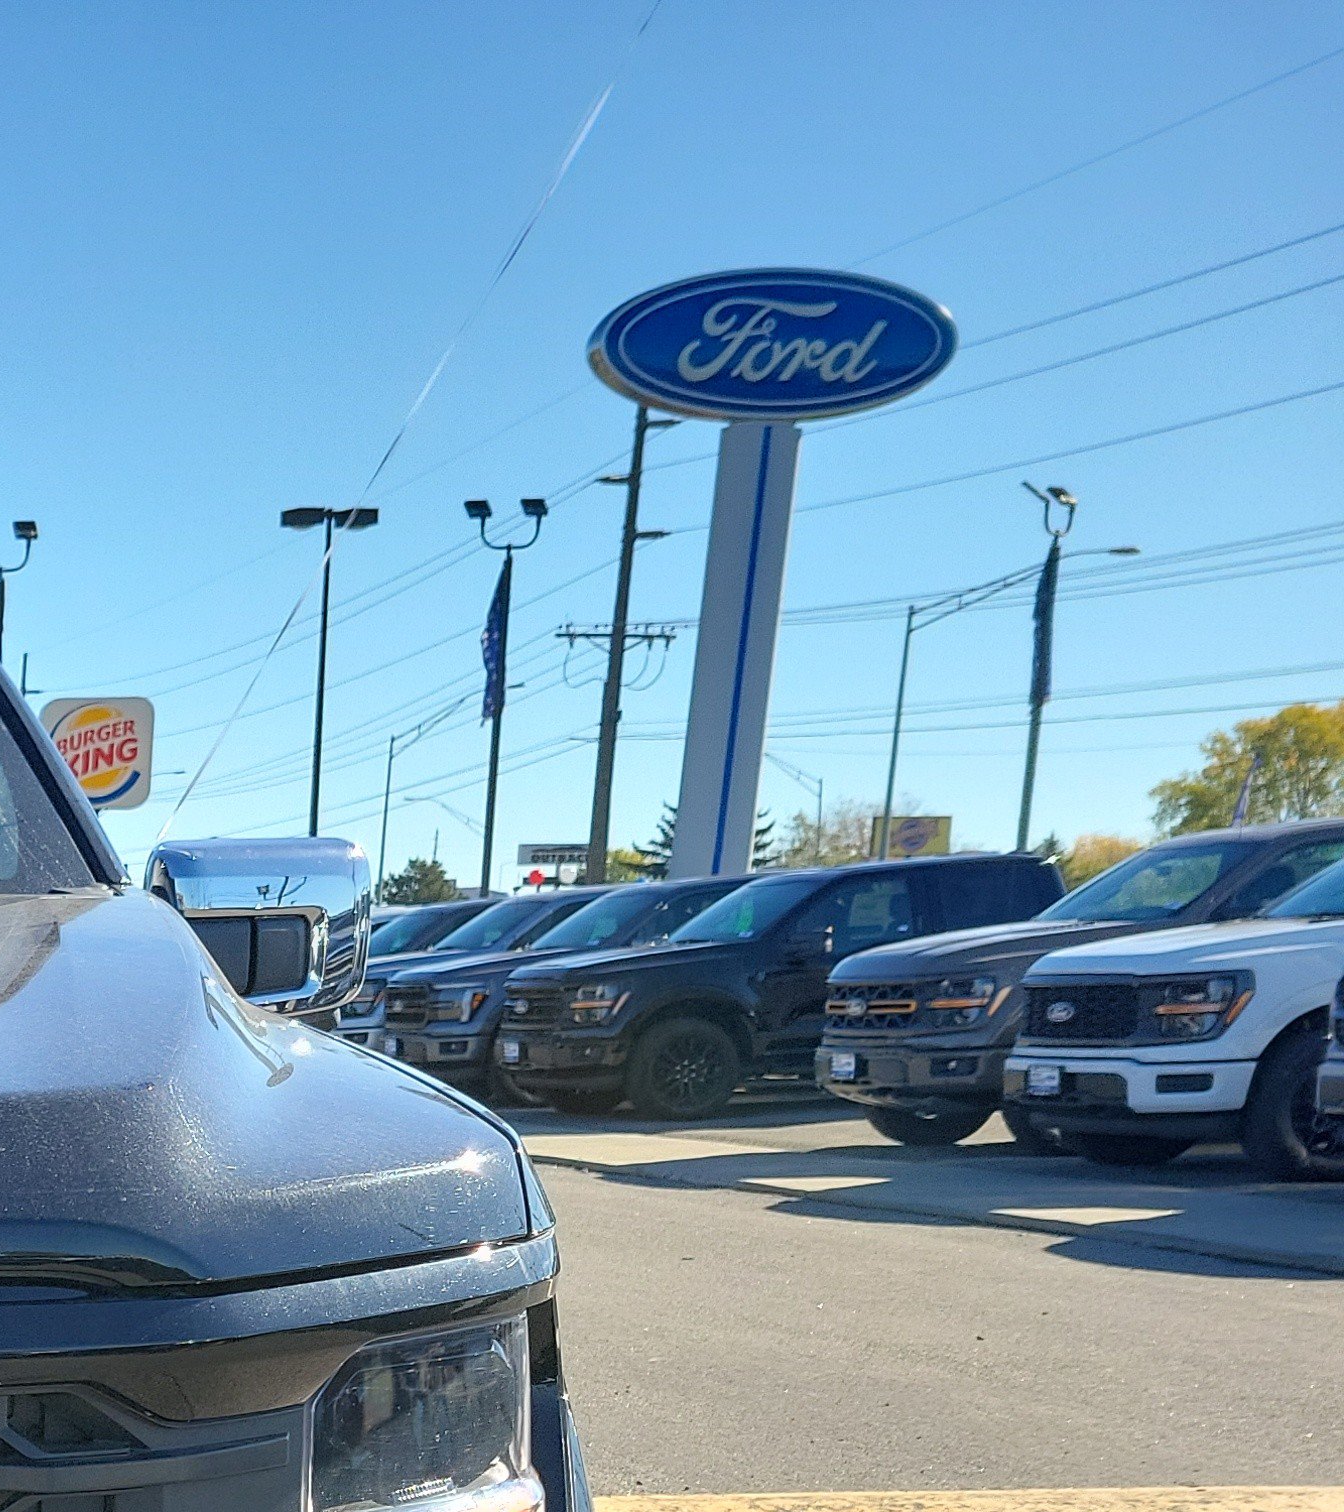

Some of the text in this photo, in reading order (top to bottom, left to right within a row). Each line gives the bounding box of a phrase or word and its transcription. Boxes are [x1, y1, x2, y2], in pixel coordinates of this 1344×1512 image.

[677, 296, 888, 383] Ford
[57, 720, 135, 756] BURGER
[530, 854, 589, 864] OUTBAC
